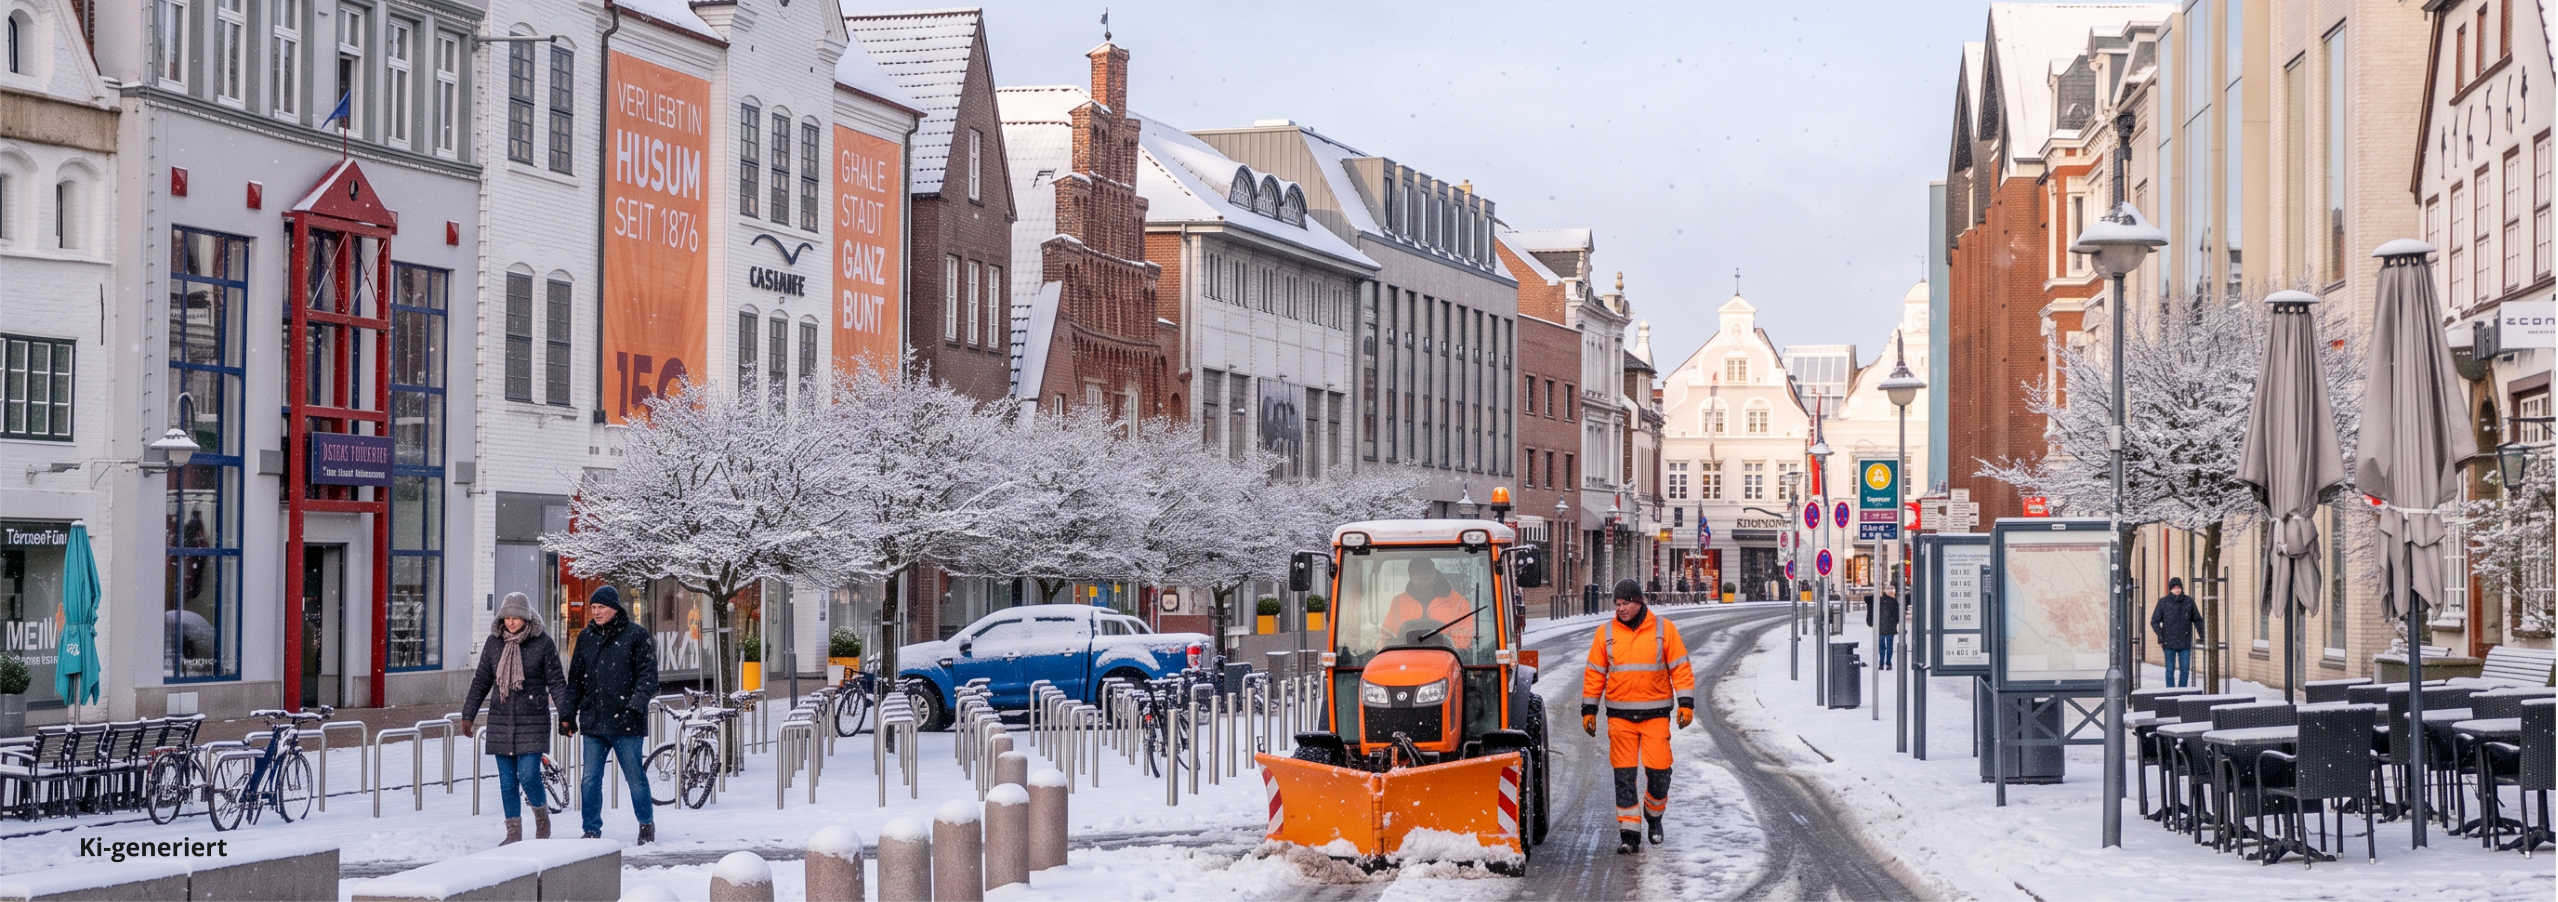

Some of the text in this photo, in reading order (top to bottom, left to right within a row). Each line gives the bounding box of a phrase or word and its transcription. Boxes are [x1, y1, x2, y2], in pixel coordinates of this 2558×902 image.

[617, 80, 702, 136] VERLIEBT IN
[616, 128, 701, 200] HUSUM
[841, 150, 886, 193] GHALE
[615, 196, 698, 252] SEIT 1876
[841, 193, 885, 236] STADT
[843, 239, 885, 286] GANZ
[843, 289, 885, 335] BUNT
